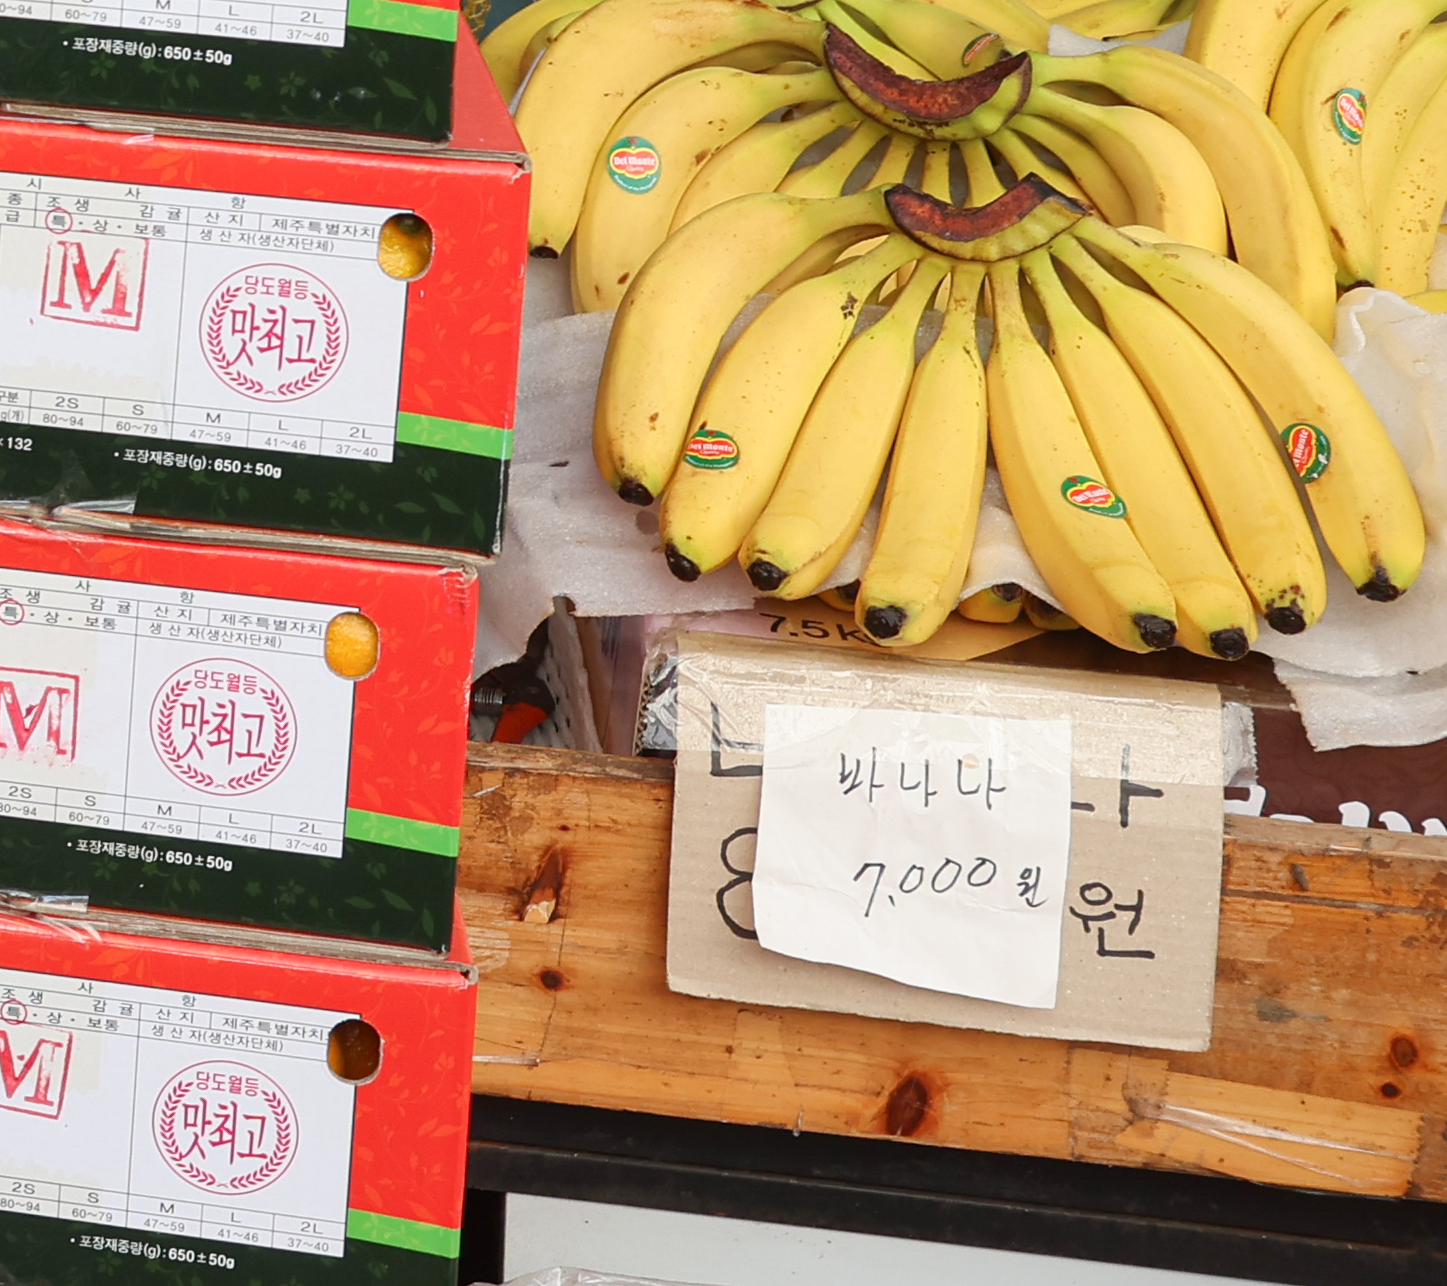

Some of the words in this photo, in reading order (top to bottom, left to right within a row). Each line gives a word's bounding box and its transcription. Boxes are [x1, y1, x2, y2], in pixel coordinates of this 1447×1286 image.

[614, 156, 627, 165] Del
[629, 156, 656, 165] Monte
[49, 240, 133, 318] M
[244, 275, 309, 300] 당도월등
[229, 302, 317, 371] 맛최고
[194, 668, 258, 694] 당도월등
[180, 695, 266, 765] 맛최고
[838, 745, 1007, 810] 바나나
[195, 1070, 260, 1096] 당도월등
[181, 1096, 269, 1166] 맛최고
